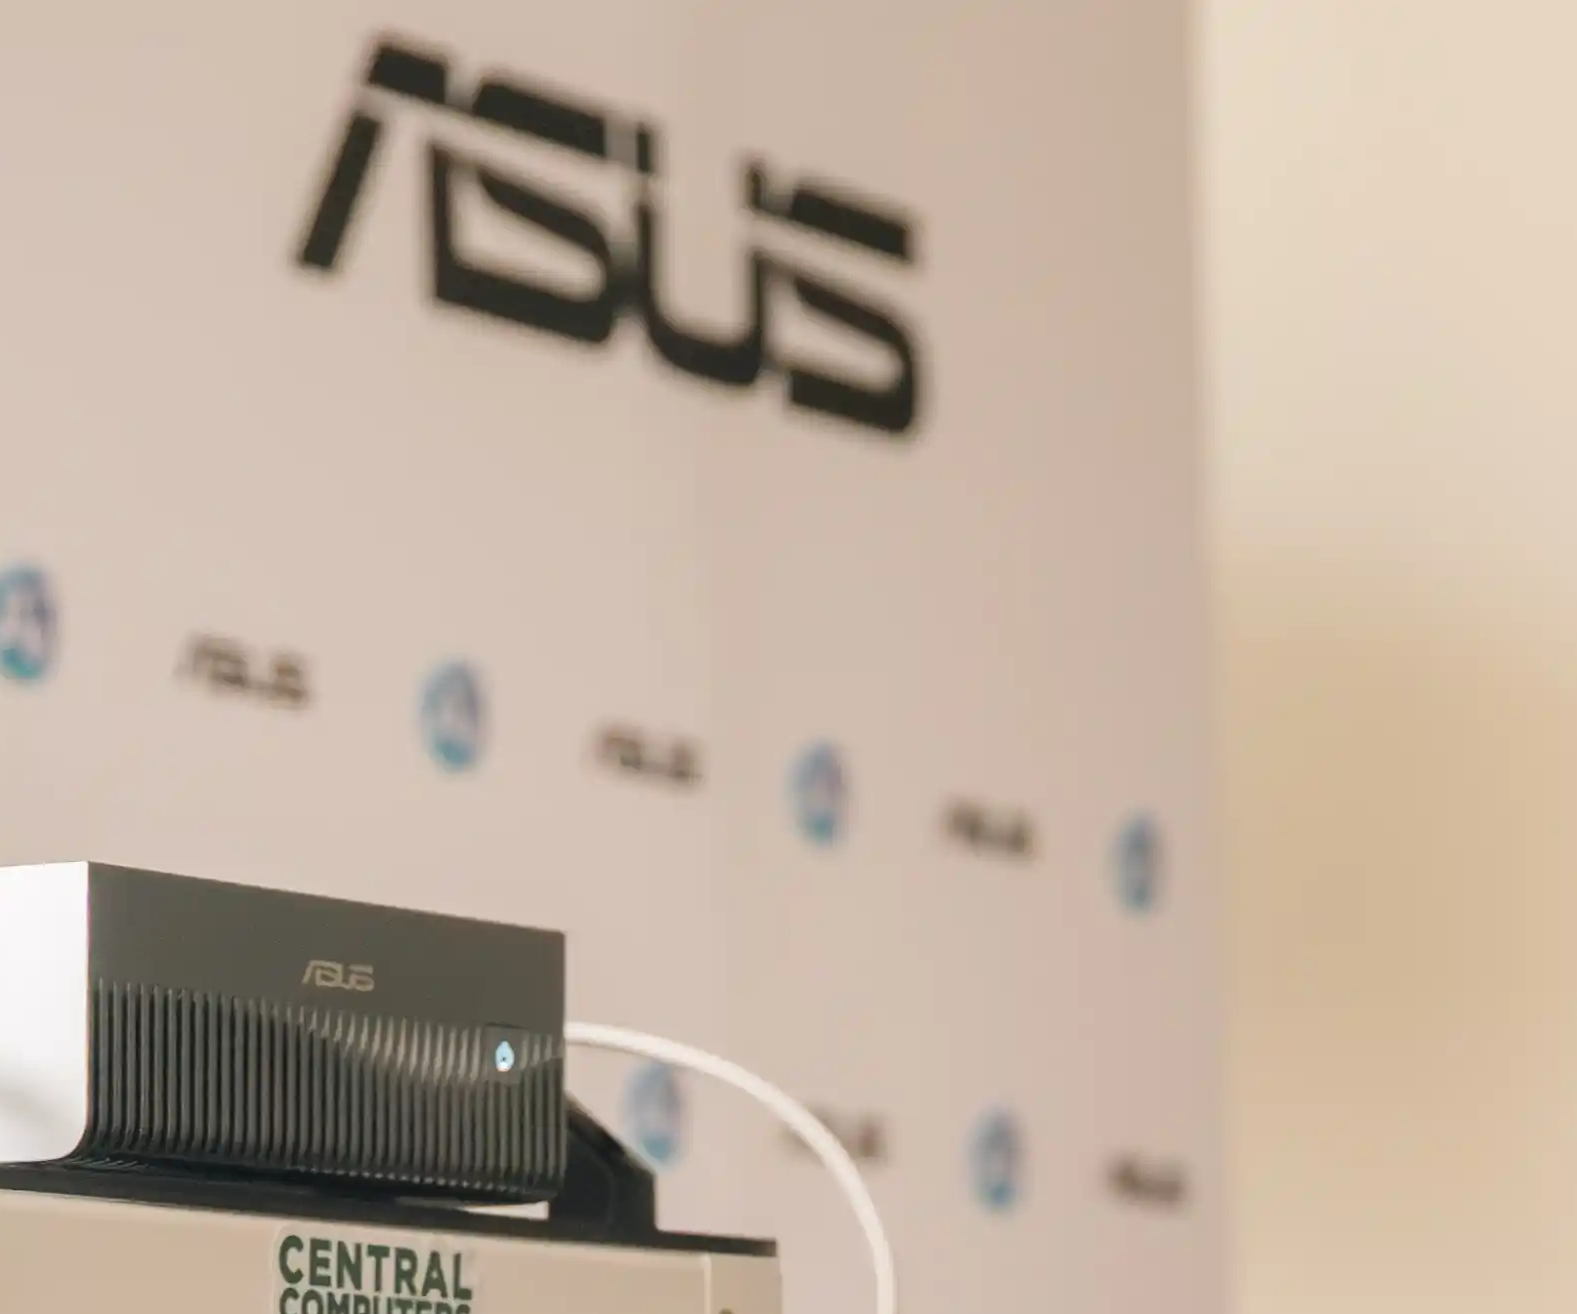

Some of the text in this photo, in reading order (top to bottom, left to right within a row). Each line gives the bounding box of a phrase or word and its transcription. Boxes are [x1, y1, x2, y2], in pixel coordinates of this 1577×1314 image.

[292, 37, 923, 438] ASUS
[302, 959, 375, 992] ASUS
[279, 1234, 472, 1301] CENTRAL
